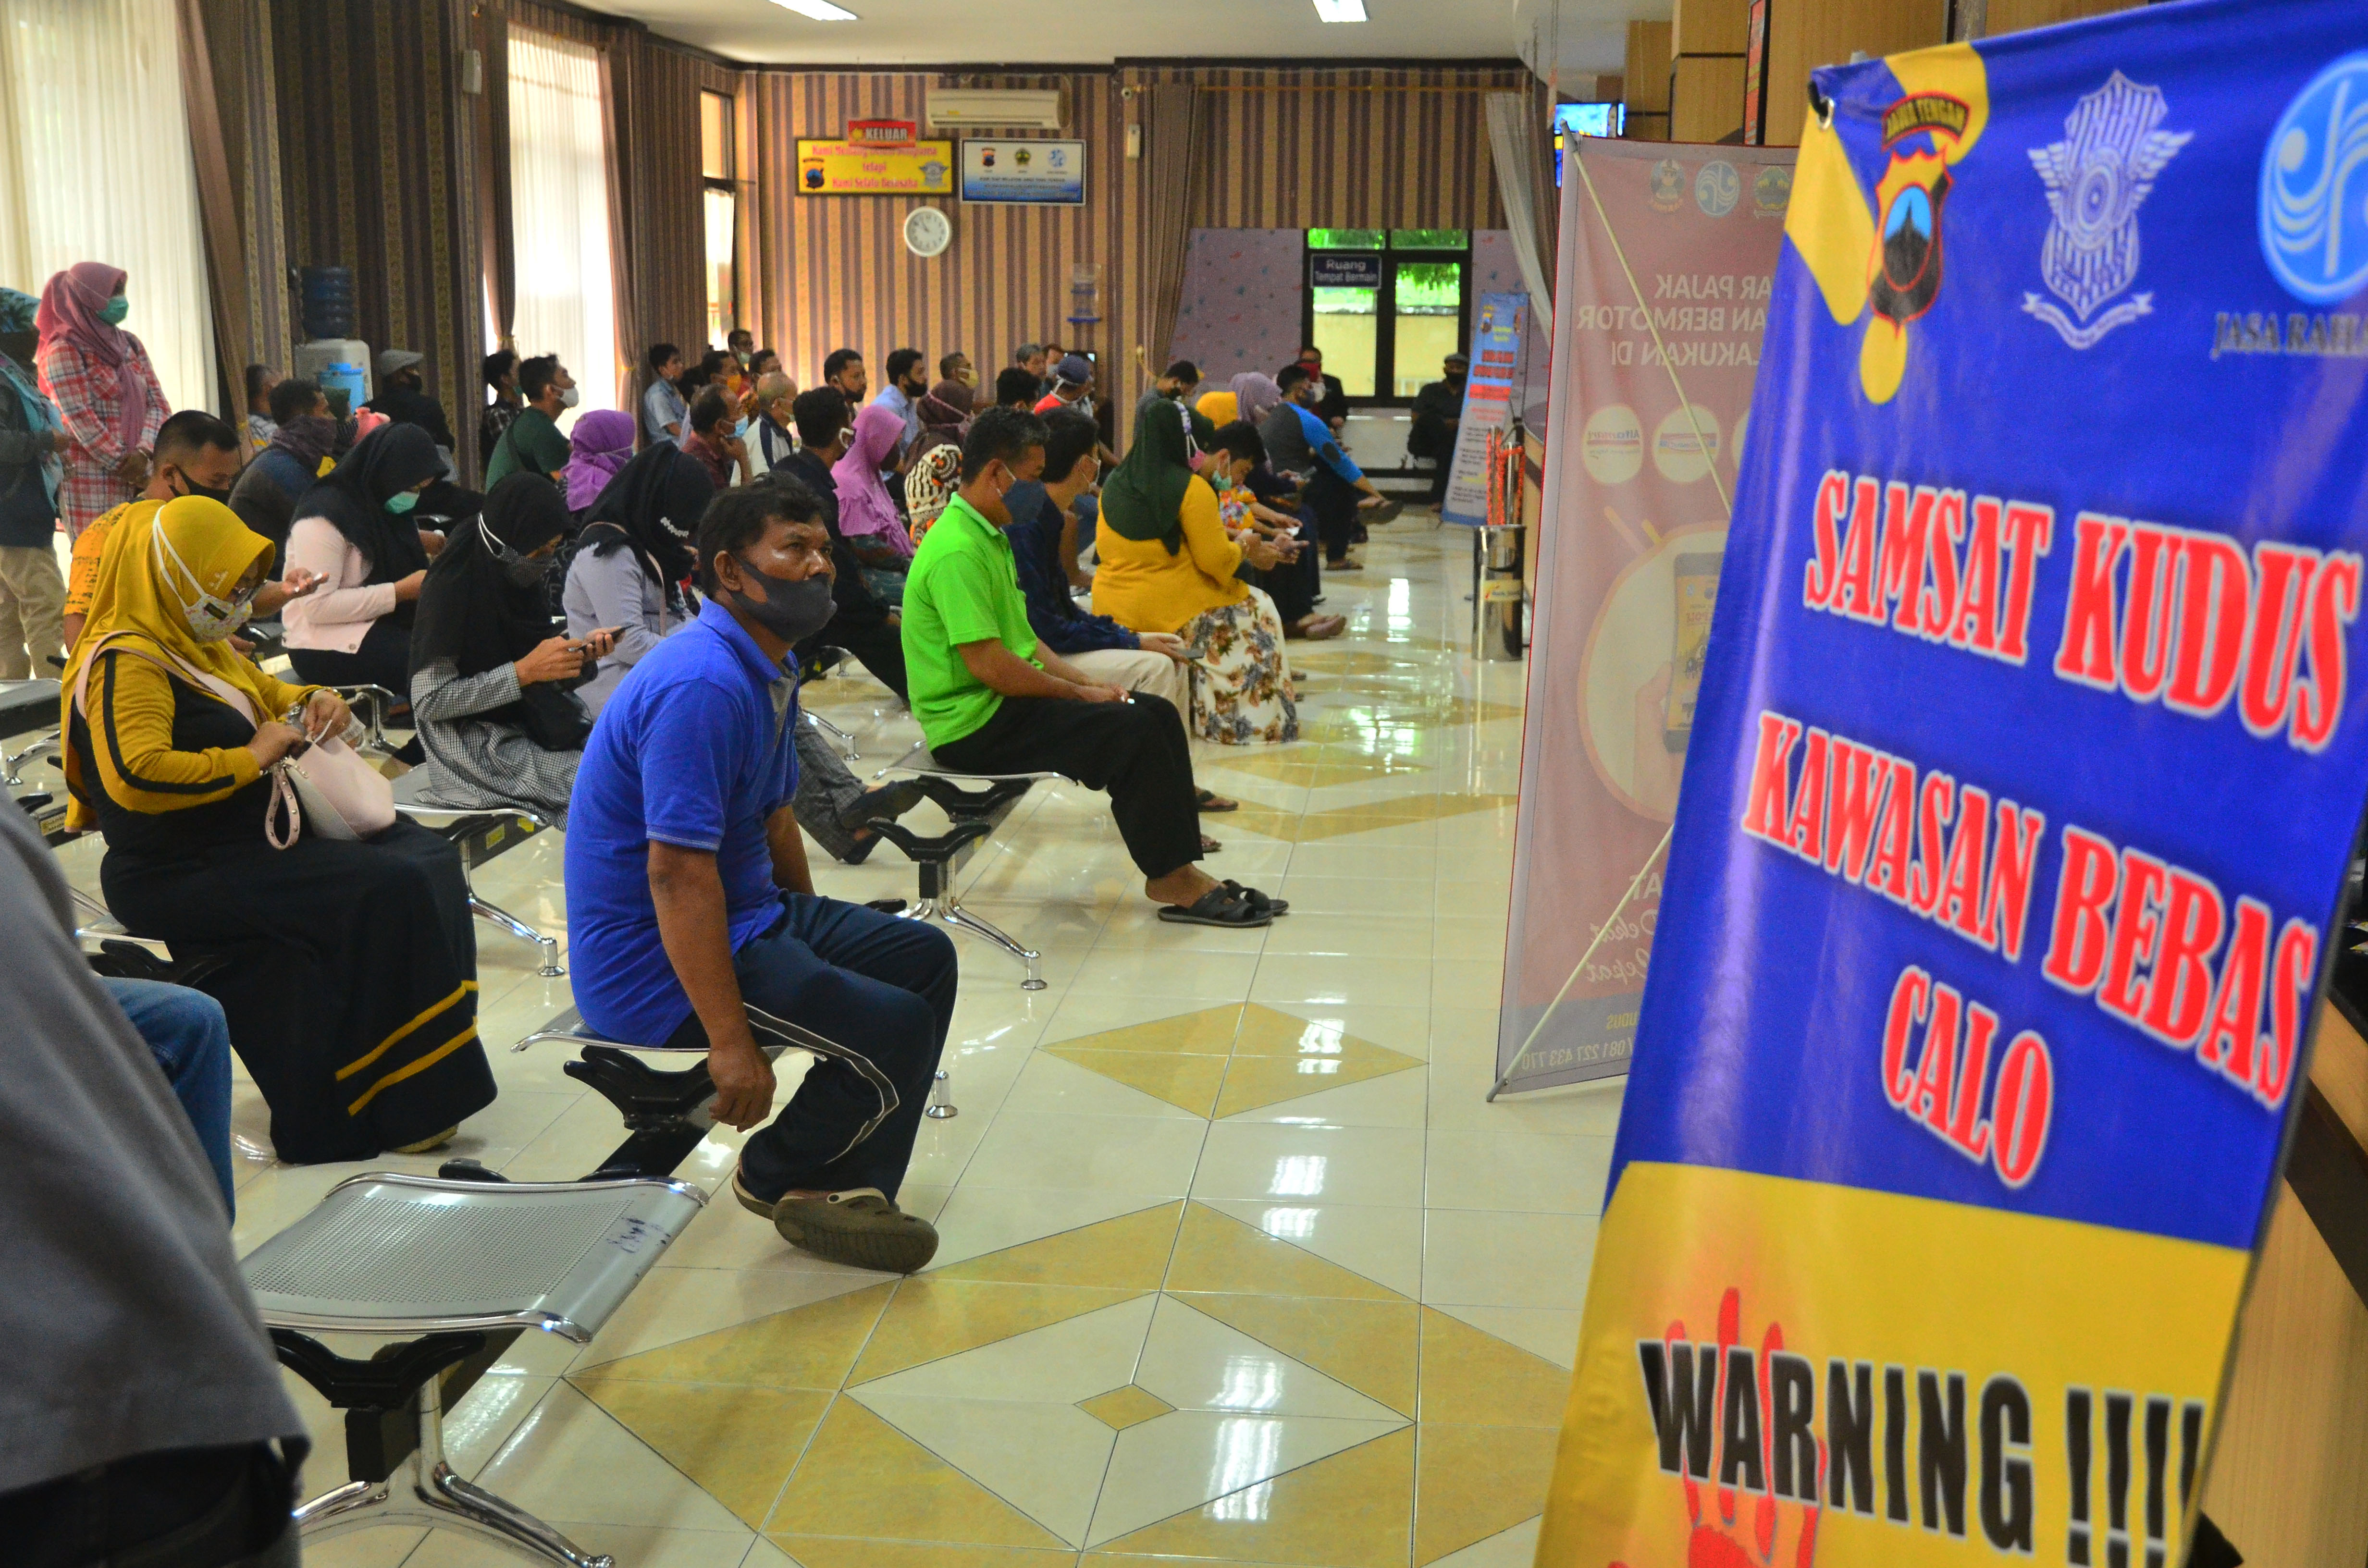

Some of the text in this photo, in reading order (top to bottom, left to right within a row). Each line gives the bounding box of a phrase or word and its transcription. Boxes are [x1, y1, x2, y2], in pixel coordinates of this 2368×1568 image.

[1887, 98, 1965, 140] JAWA TENGAH
[865, 127, 907, 140] KELUAR
[813, 145, 832, 155] Kami
[863, 162, 886, 173] tetapi
[832, 178, 852, 188] Kami
[855, 178, 879, 188] Selalu
[1315, 271, 1377, 282] Tempat Bermain
[1326, 258, 1366, 272] Ruang
[2209, 311, 2280, 361] JASA
[1804, 469, 2364, 753] SAMSAT KUDUS
[1740, 709, 2319, 1110] KAWASAN BEBAS
[1881, 966, 2054, 1188] CALO
[1636, 1339, 2035, 1555] WARNING
